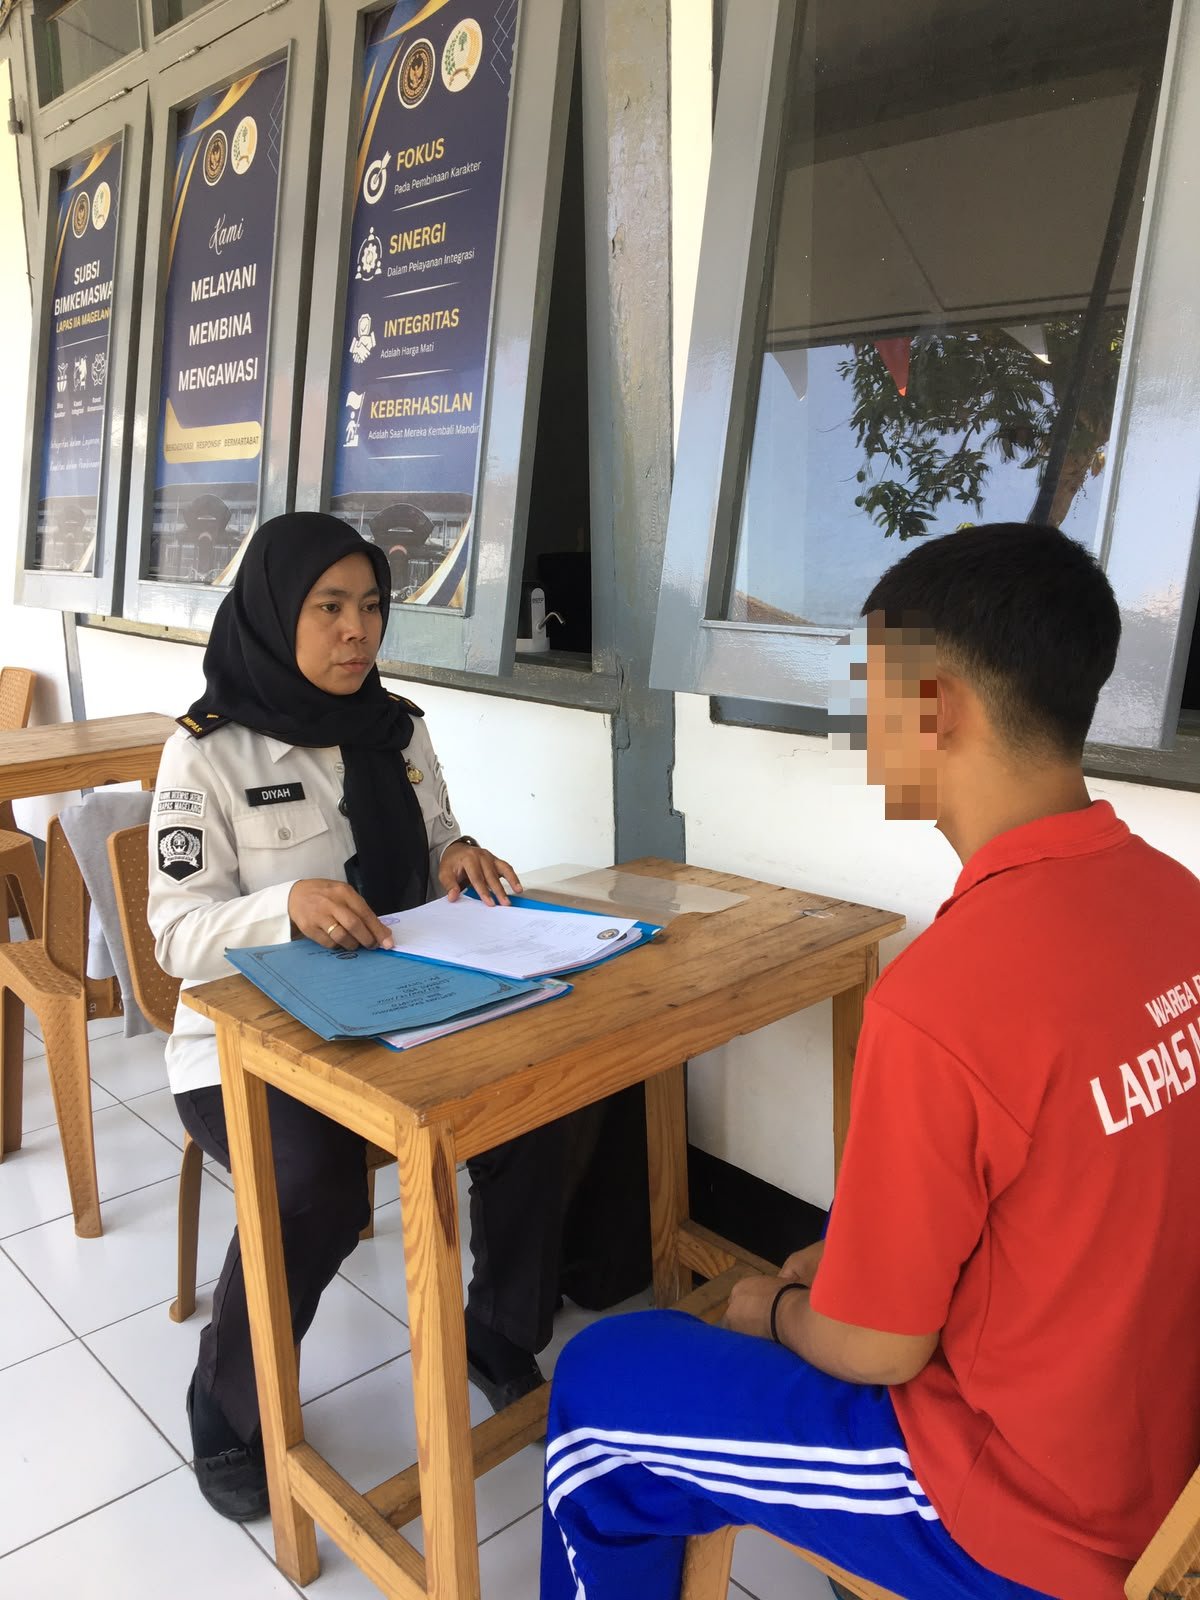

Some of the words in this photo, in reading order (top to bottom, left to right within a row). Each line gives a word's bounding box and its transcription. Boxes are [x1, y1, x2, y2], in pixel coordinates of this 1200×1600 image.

[396, 138, 445, 172] FOKUS
[394, 184, 411, 195] Pada
[411, 171, 450, 189] Pembinaan
[450, 161, 482, 178] Karakter
[208, 213, 244, 255] Kami
[389, 222, 446, 254] SINERGI
[73, 260, 100, 285] SUBSI
[387, 265, 409, 277] Dalam
[408, 256, 443, 272] Pelayanan
[443, 247, 475, 264] Integrasi
[190, 263, 257, 302] MELAYANI
[188, 312, 252, 346] MEMBINA
[384, 308, 460, 338] INTEGRITAS
[380, 347, 401, 359] Adalah
[401, 346, 420, 357] Harga
[420, 342, 435, 353] Mati
[178, 357, 258, 392] MENGAWASI
[370, 392, 473, 419] KEBERHASILAN
[368, 430, 389, 440] Adalah
[389, 428, 403, 438] Saat
[404, 427, 427, 438] Mereka
[428, 424, 454, 436] Kembali
[261, 788, 291, 800] DIYAH
[1144, 981, 1199, 1028] WARGA
[1090, 1030, 1197, 1136] LAPAS
